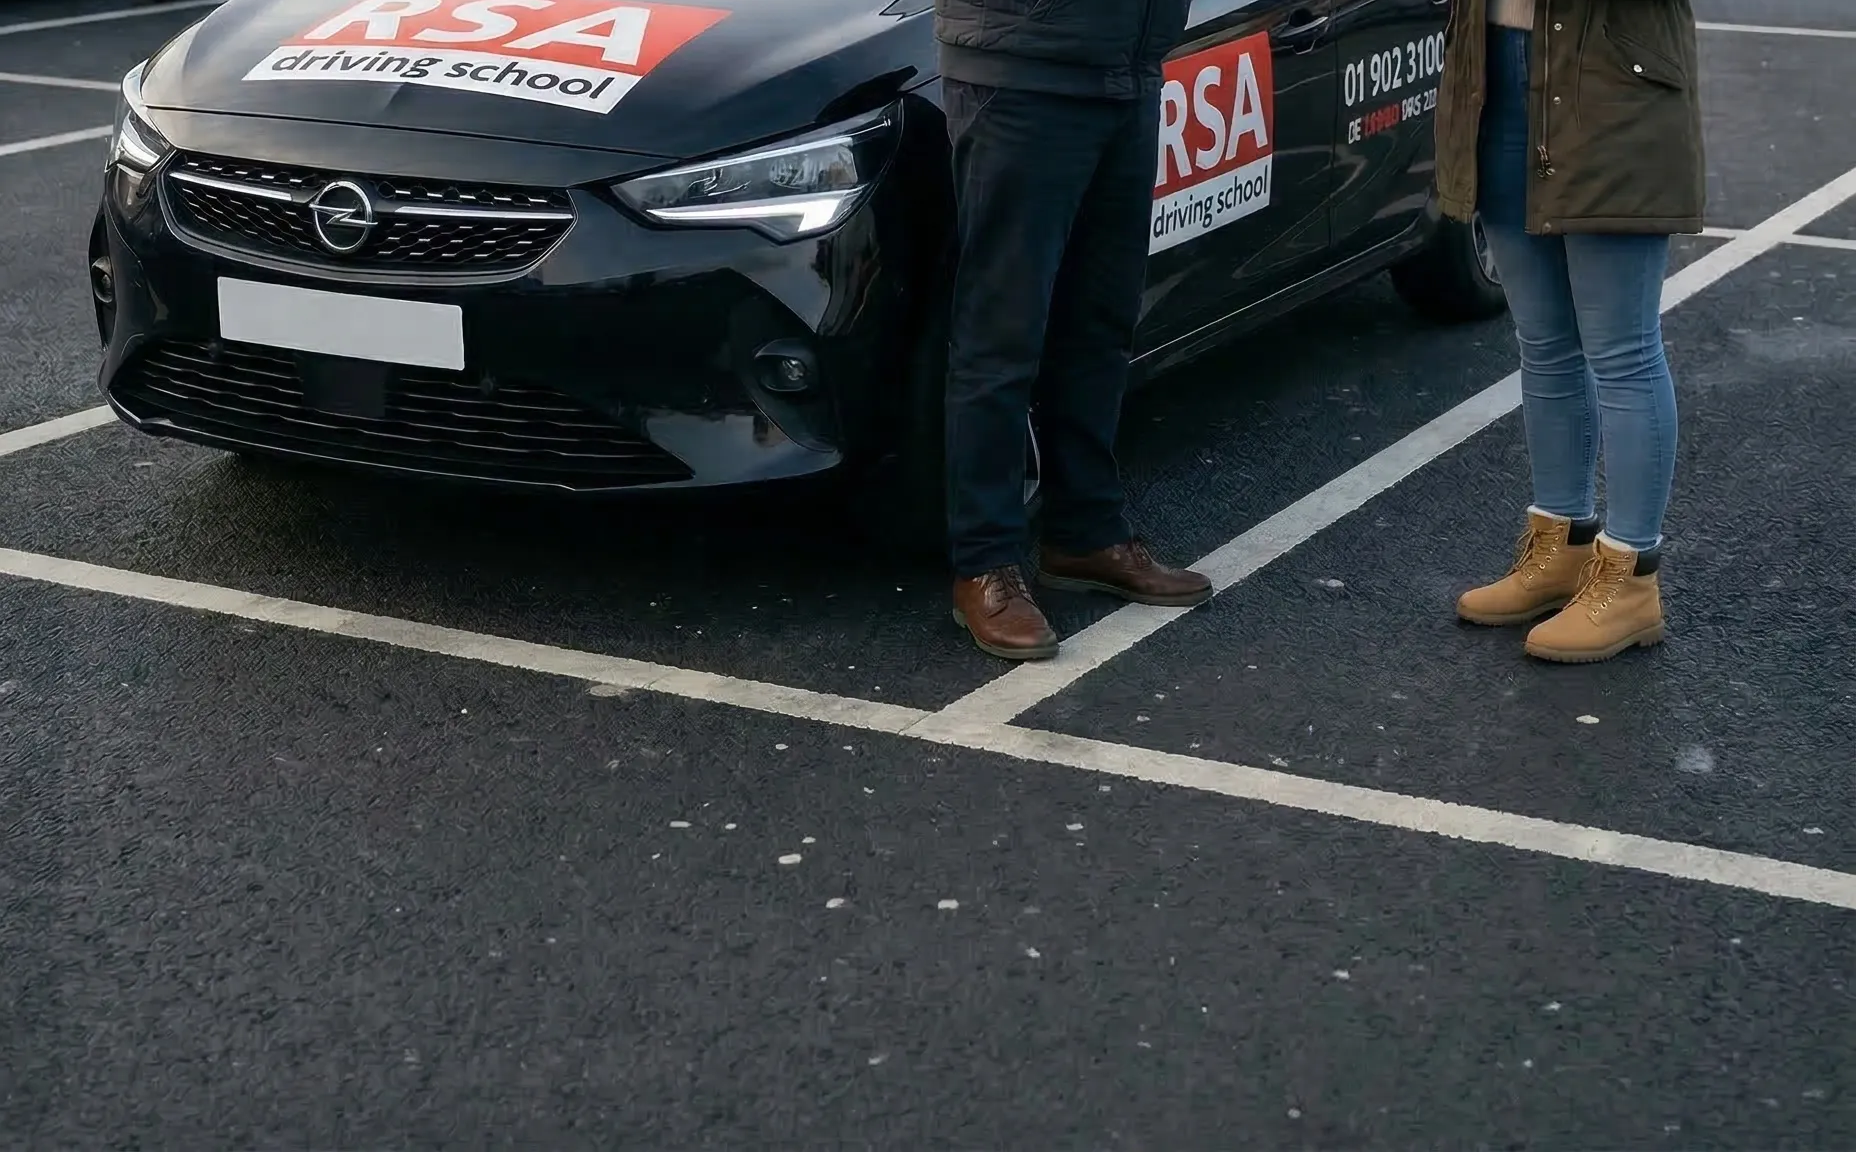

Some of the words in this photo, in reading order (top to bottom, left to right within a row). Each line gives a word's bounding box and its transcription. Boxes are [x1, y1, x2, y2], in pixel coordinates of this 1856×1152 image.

[272, 49, 443, 78] driving
[444, 60, 615, 100] school
[1344, 58, 1364, 107] 01
[1370, 46, 1402, 97] 902
[1407, 31, 1445, 84] 3100
[1155, 52, 1268, 188] RSA
[1153, 195, 1214, 238] driving
[1217, 165, 1268, 215] school
